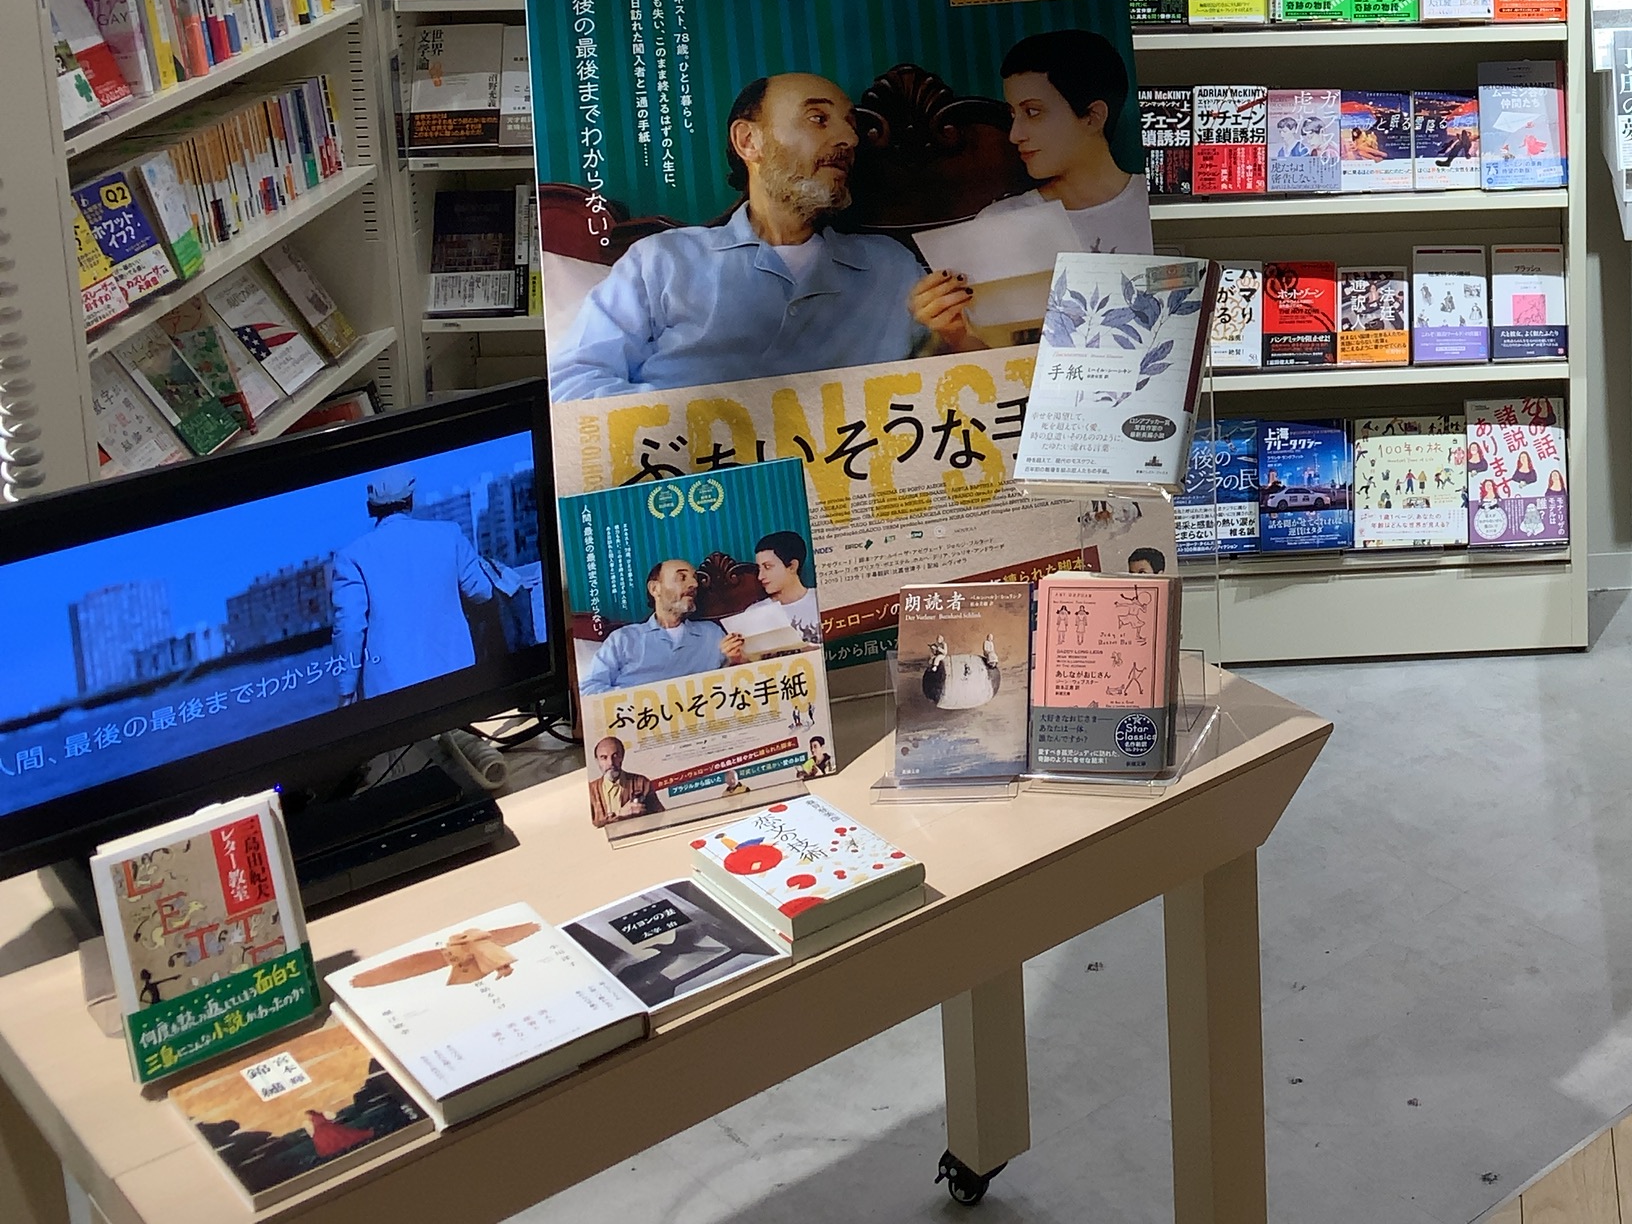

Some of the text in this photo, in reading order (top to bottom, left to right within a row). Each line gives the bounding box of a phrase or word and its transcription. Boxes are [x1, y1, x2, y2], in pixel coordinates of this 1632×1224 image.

[1285, 1, 1332, 11] 奇跡の物語
[1353, 2, 1400, 12] 奇跡の物語
[417, 29, 431, 72] 文学論
[430, 29, 444, 57] 世界
[1154, 89, 1192, 101] McKINTY
[1197, 88, 1229, 98] ADRIAN
[1492, 88, 1547, 98] ムーミン谷の
[1500, 98, 1541, 109] 仲間たち
[1197, 127, 1266, 144] 連鎖誘拐
[1319, 89, 1341, 167] ガラスの
[1270, 163, 1305, 173] 虎たちは
[105, 186, 128, 204] Q2
[1238, 268, 1259, 324] ハマり
[1349, 279, 1367, 331] 通訳人
[1379, 286, 1396, 322] 法廷
[1047, 364, 1084, 382] 手紙
[1264, 427, 1290, 442] 上海
[1493, 404, 1529, 454] 諸説
[1264, 440, 1323, 452] フリータクシー
[1377, 442, 1444, 459] 100年の旅
[1229, 527, 1256, 537] 椎名誠
[581, 504, 604, 636] 人間、最後の最後までわからない。
[903, 591, 966, 613] 朗読者
[1055, 669, 1112, 679] あしながおじさん
[608, 672, 809, 730] ぶあいそうな手紙
[1115, 732, 1157, 742] Classics
[1125, 723, 1149, 733] Star
[1038, 748, 1121, 758] 愛すべき孤児ジュディに訪れた、
[671, 775, 722, 795] ブラジルから届いた
[752, 812, 829, 863] 恋文の技術
[220, 826, 251, 903] レター教室
[243, 818, 271, 900] 三島由紀夫
[620, 907, 677, 935] ヴィヨンの妻
[144, 987, 305, 1075] 三島にこんな小説があったのか
